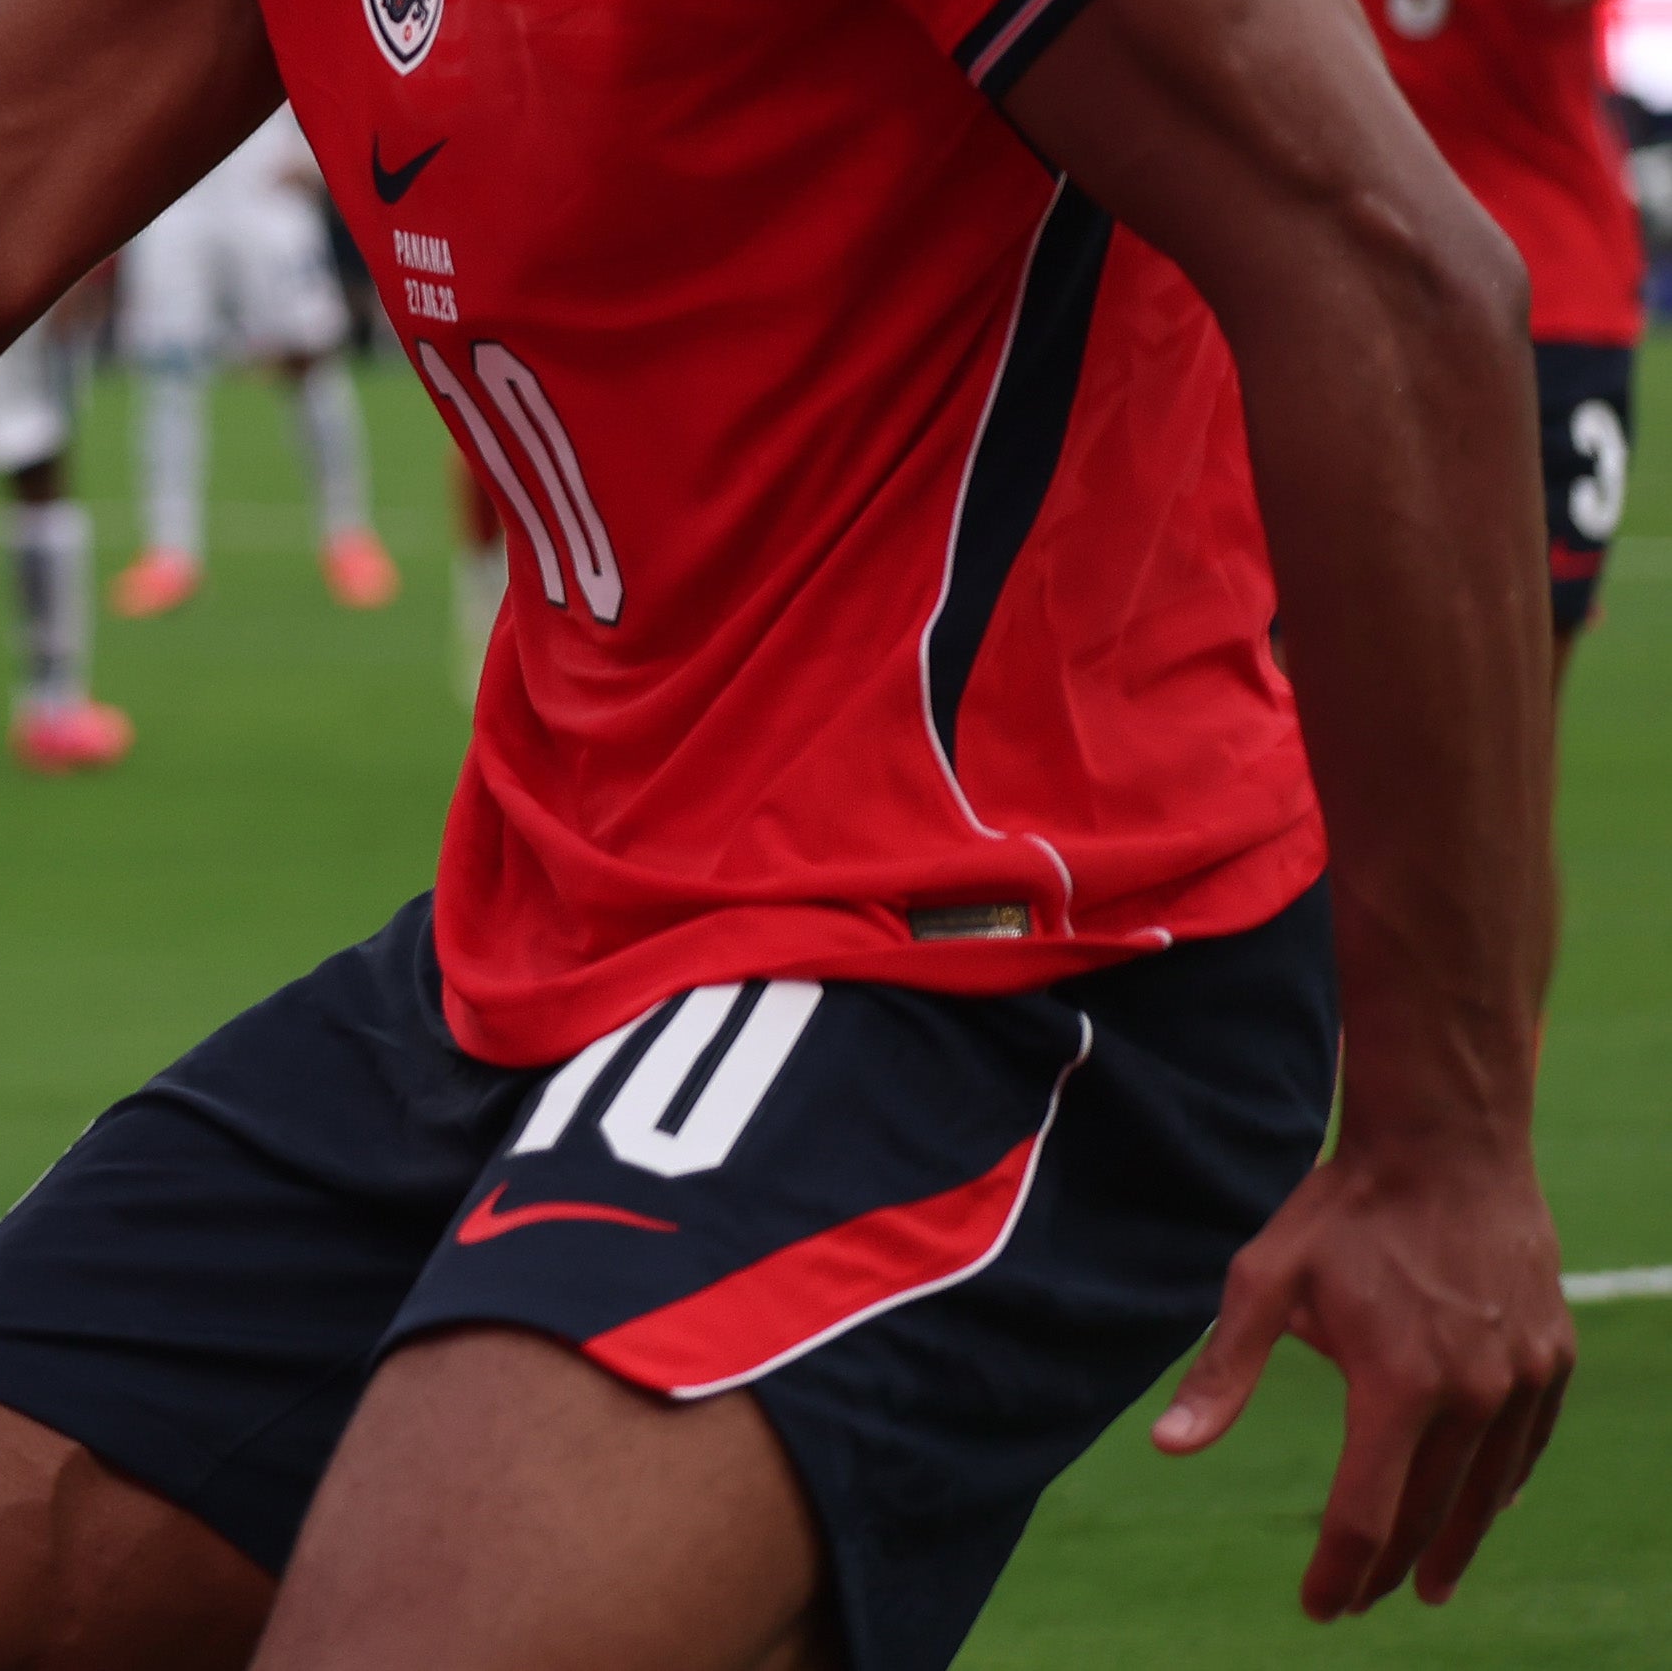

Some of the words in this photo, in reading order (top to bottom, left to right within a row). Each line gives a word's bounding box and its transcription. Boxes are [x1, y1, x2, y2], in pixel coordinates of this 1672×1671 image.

[393, 228, 455, 276] PANAMA
[417, 338, 624, 626] 10
[508, 979, 824, 1178] 10
